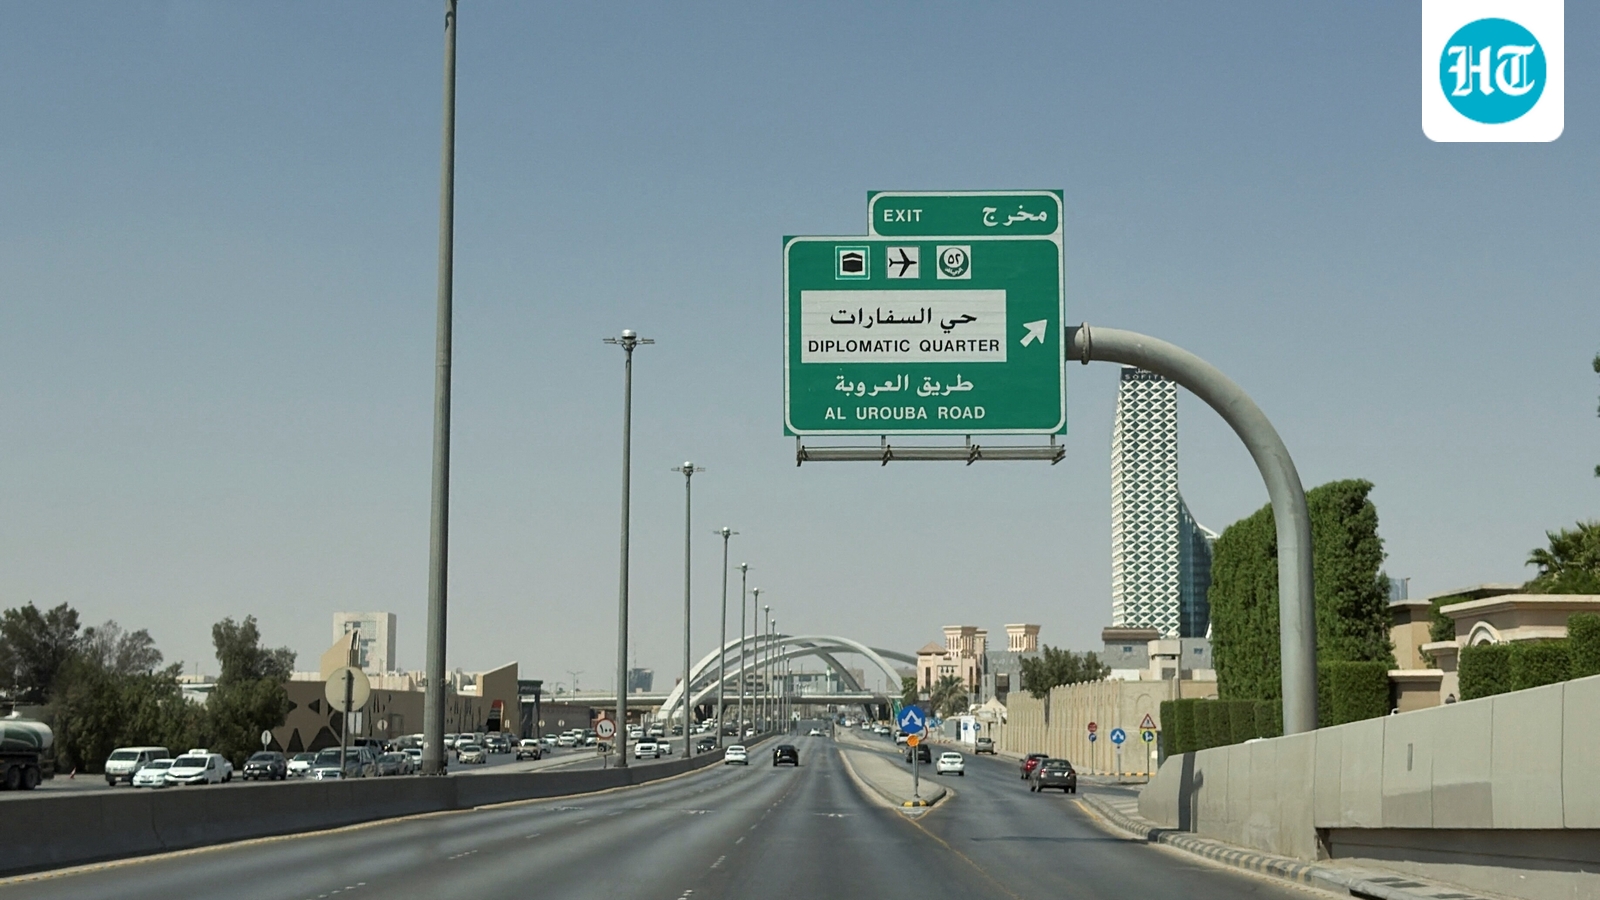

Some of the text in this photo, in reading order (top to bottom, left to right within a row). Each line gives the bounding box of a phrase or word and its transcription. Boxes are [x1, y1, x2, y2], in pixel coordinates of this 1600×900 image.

[883, 209, 923, 222] EXIT
[982, 204, 1047, 227] مخرج
[830, 307, 977, 333] حي السفارات
[808, 338, 1000, 352] DIPLOMATIC QUARTER
[834, 373, 974, 397] طريق العروبة
[824, 406, 986, 420] AL UROUBA ROAD
